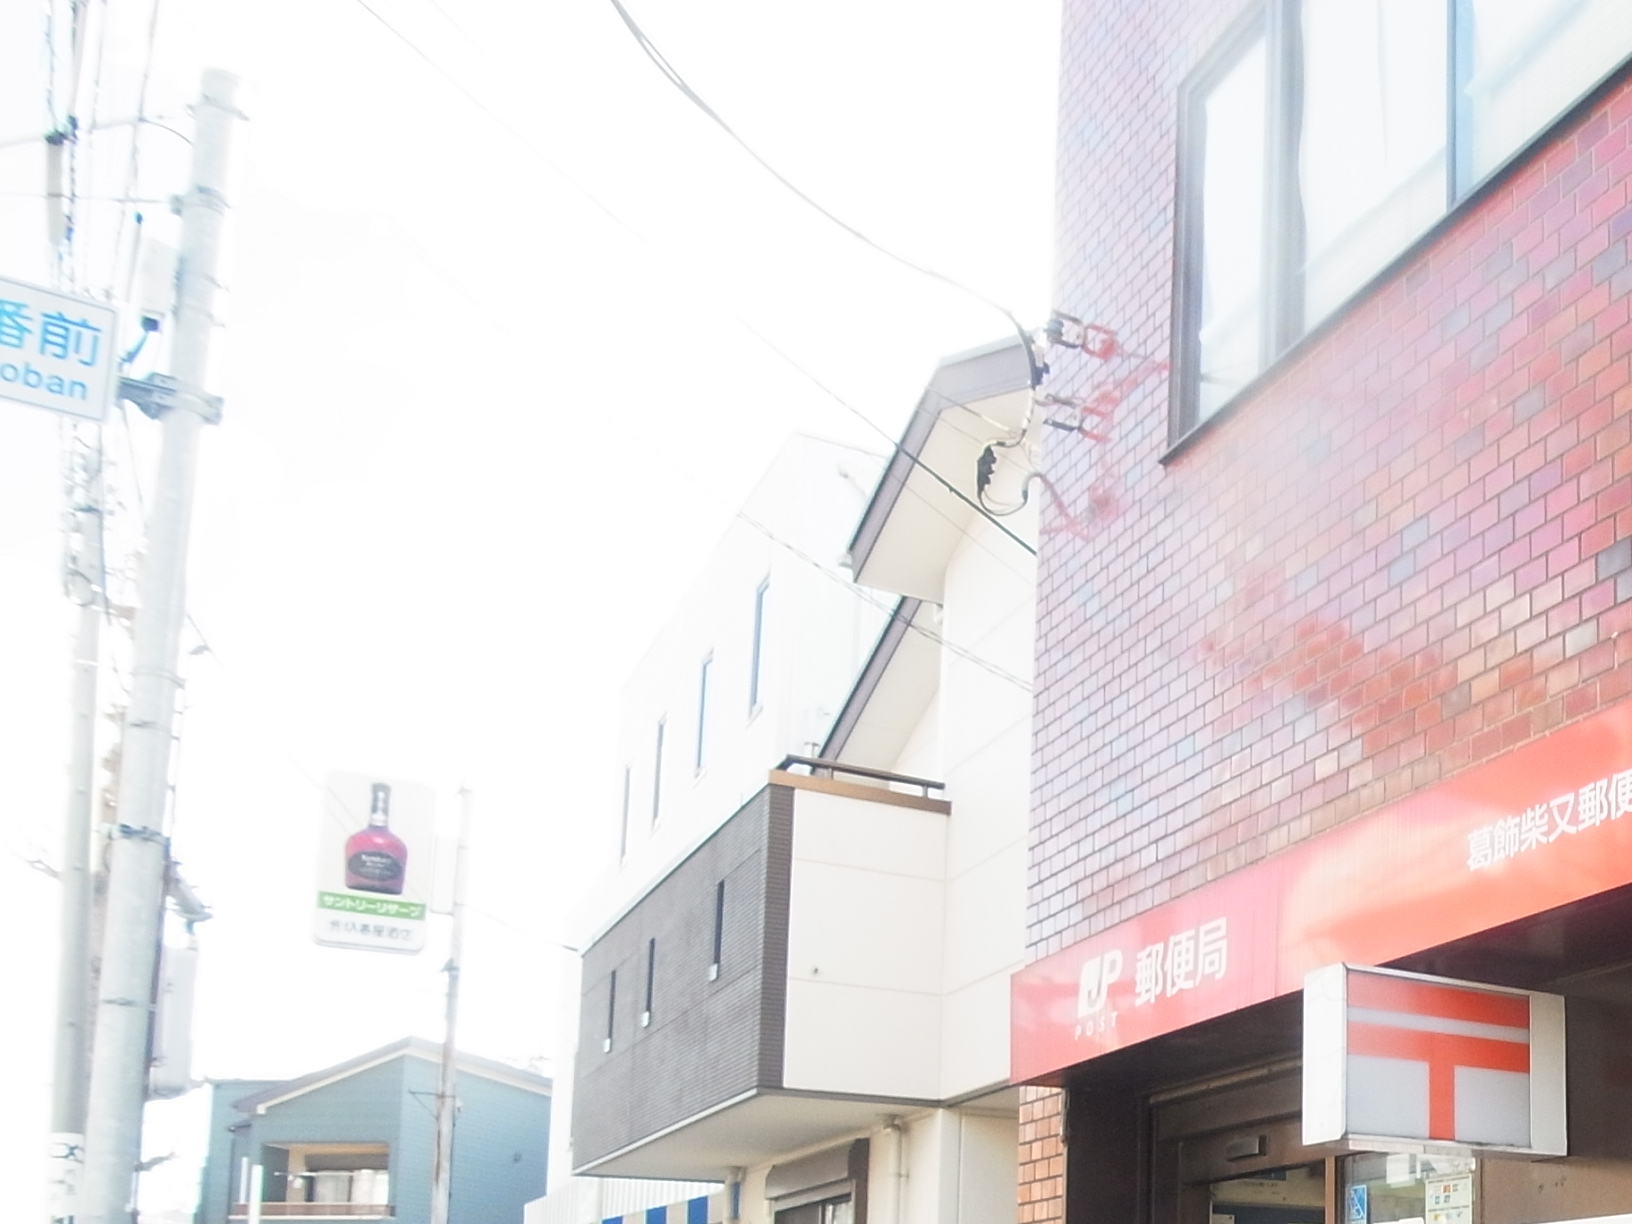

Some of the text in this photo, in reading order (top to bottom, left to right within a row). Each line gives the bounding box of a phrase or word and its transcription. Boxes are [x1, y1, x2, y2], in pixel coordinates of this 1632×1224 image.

[1135, 917, 1227, 1006] 郵便局
[1074, 1011, 1118, 1040] POST
